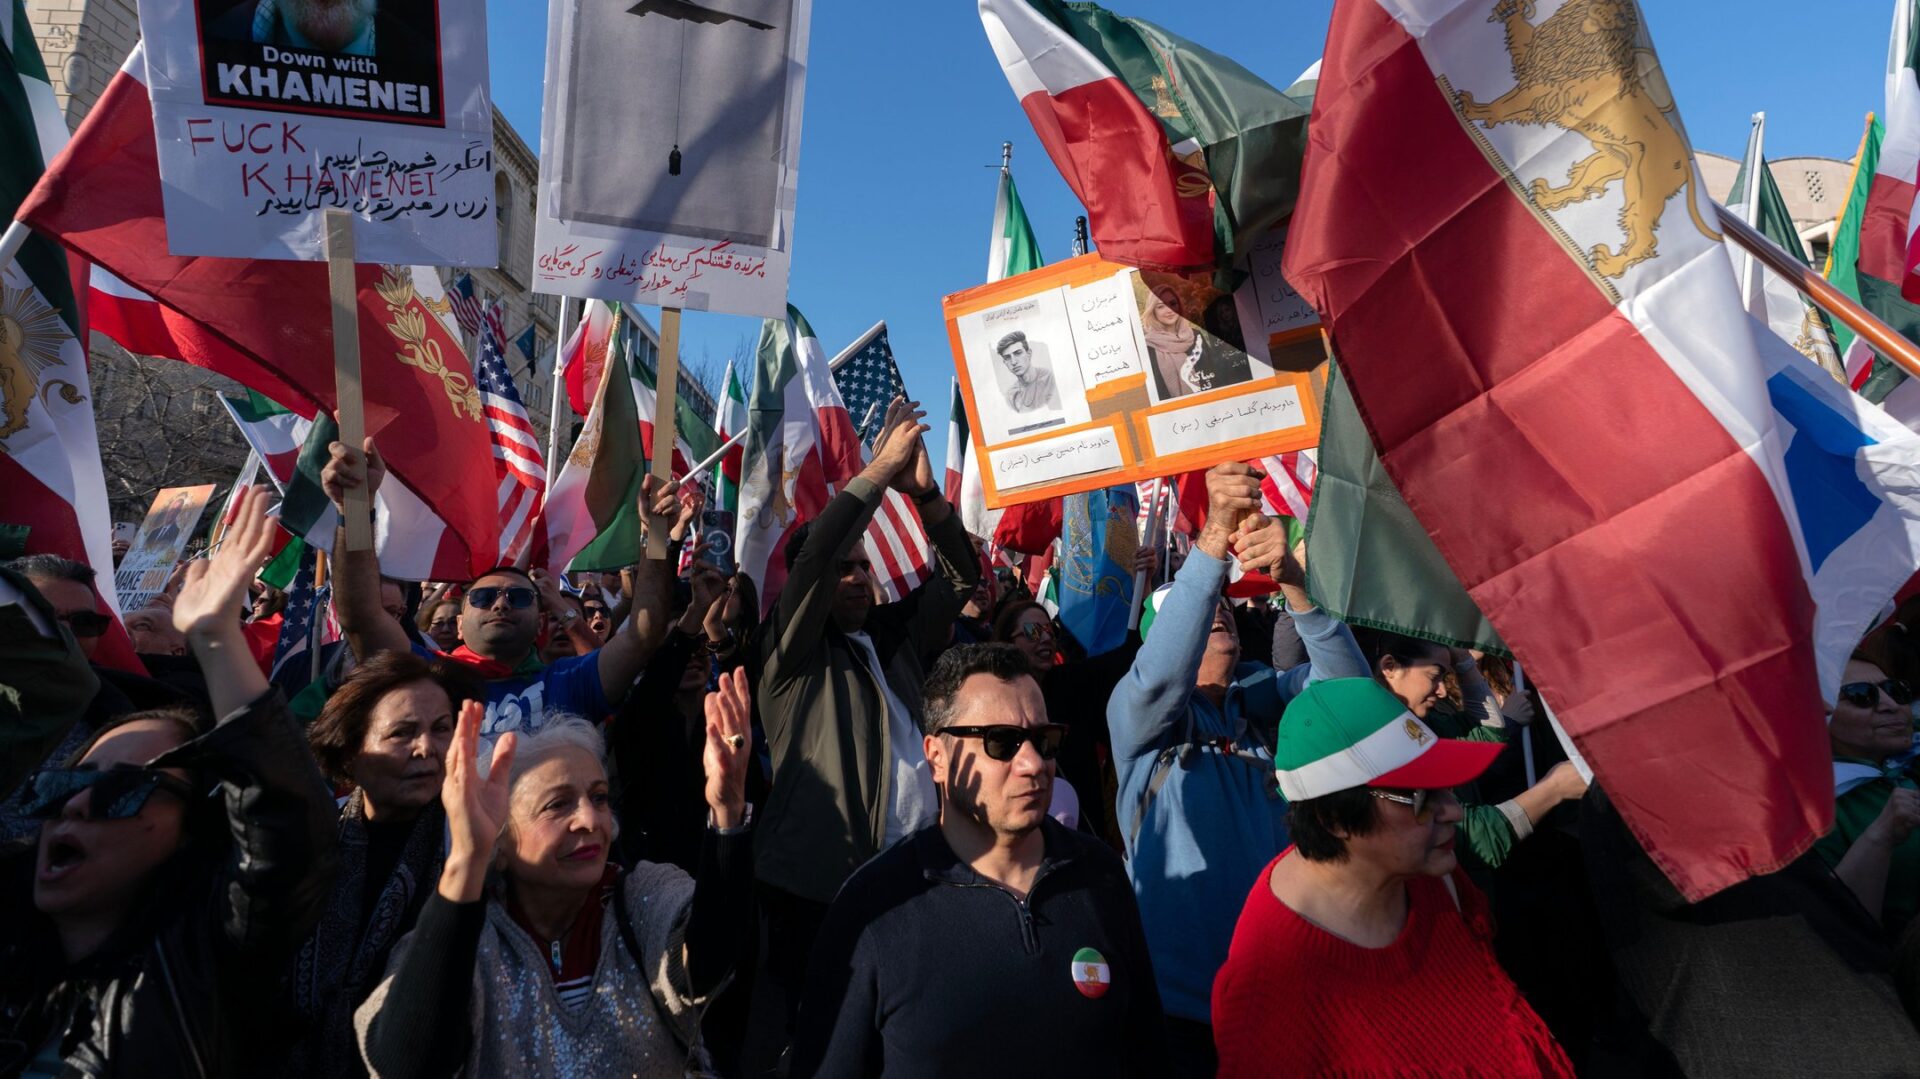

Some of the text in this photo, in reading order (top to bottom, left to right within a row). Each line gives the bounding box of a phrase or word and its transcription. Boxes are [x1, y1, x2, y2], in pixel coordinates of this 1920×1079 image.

[262, 45, 379, 75] Down with
[216, 62, 432, 114] KHAMENEI
[186, 118, 306, 156] FUCK
[242, 161, 439, 199] KHAMENEI
[455, 196, 489, 220] زن
[114, 569, 145, 591] MAKE
